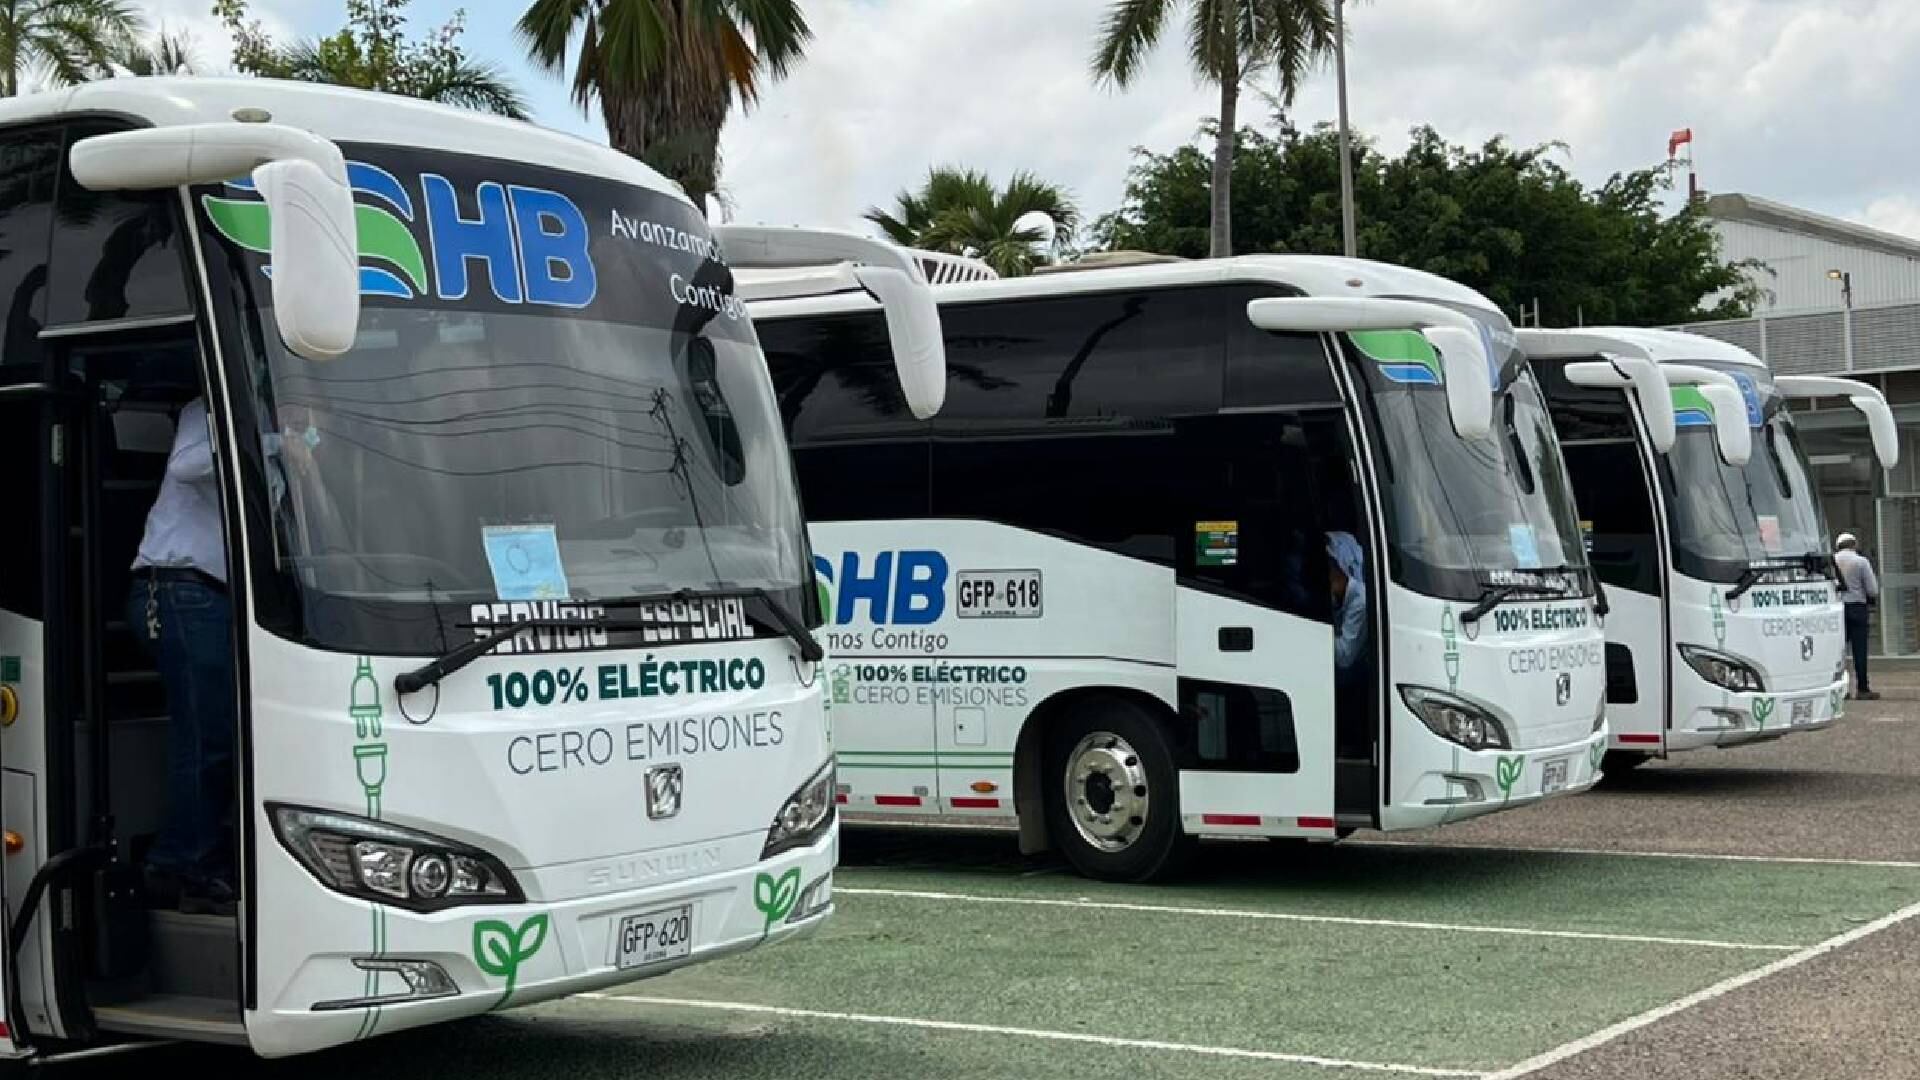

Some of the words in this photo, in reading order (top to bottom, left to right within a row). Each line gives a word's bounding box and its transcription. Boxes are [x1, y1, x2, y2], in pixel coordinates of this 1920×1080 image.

[419, 172, 597, 309] HB
[670, 273, 746, 320] Contigo
[836, 550, 949, 625] HB
[471, 600, 608, 653] SERVICIO
[640, 597, 755, 642] ESPECIAL
[871, 627, 949, 653] Contigo
[1494, 607, 1530, 632] 100%
[486, 666, 589, 711] 100%
[598, 653, 765, 702] ELÉCTRICO
[854, 665, 907, 683] 100%
[911, 660, 1026, 683] ELÉCTRICO
[1508, 648, 1548, 674] CERO
[853, 686, 910, 705] CERO
[916, 685, 1028, 706] EMISIONES
[507, 727, 614, 775] CERO
[626, 711, 784, 761] EMISIONES
